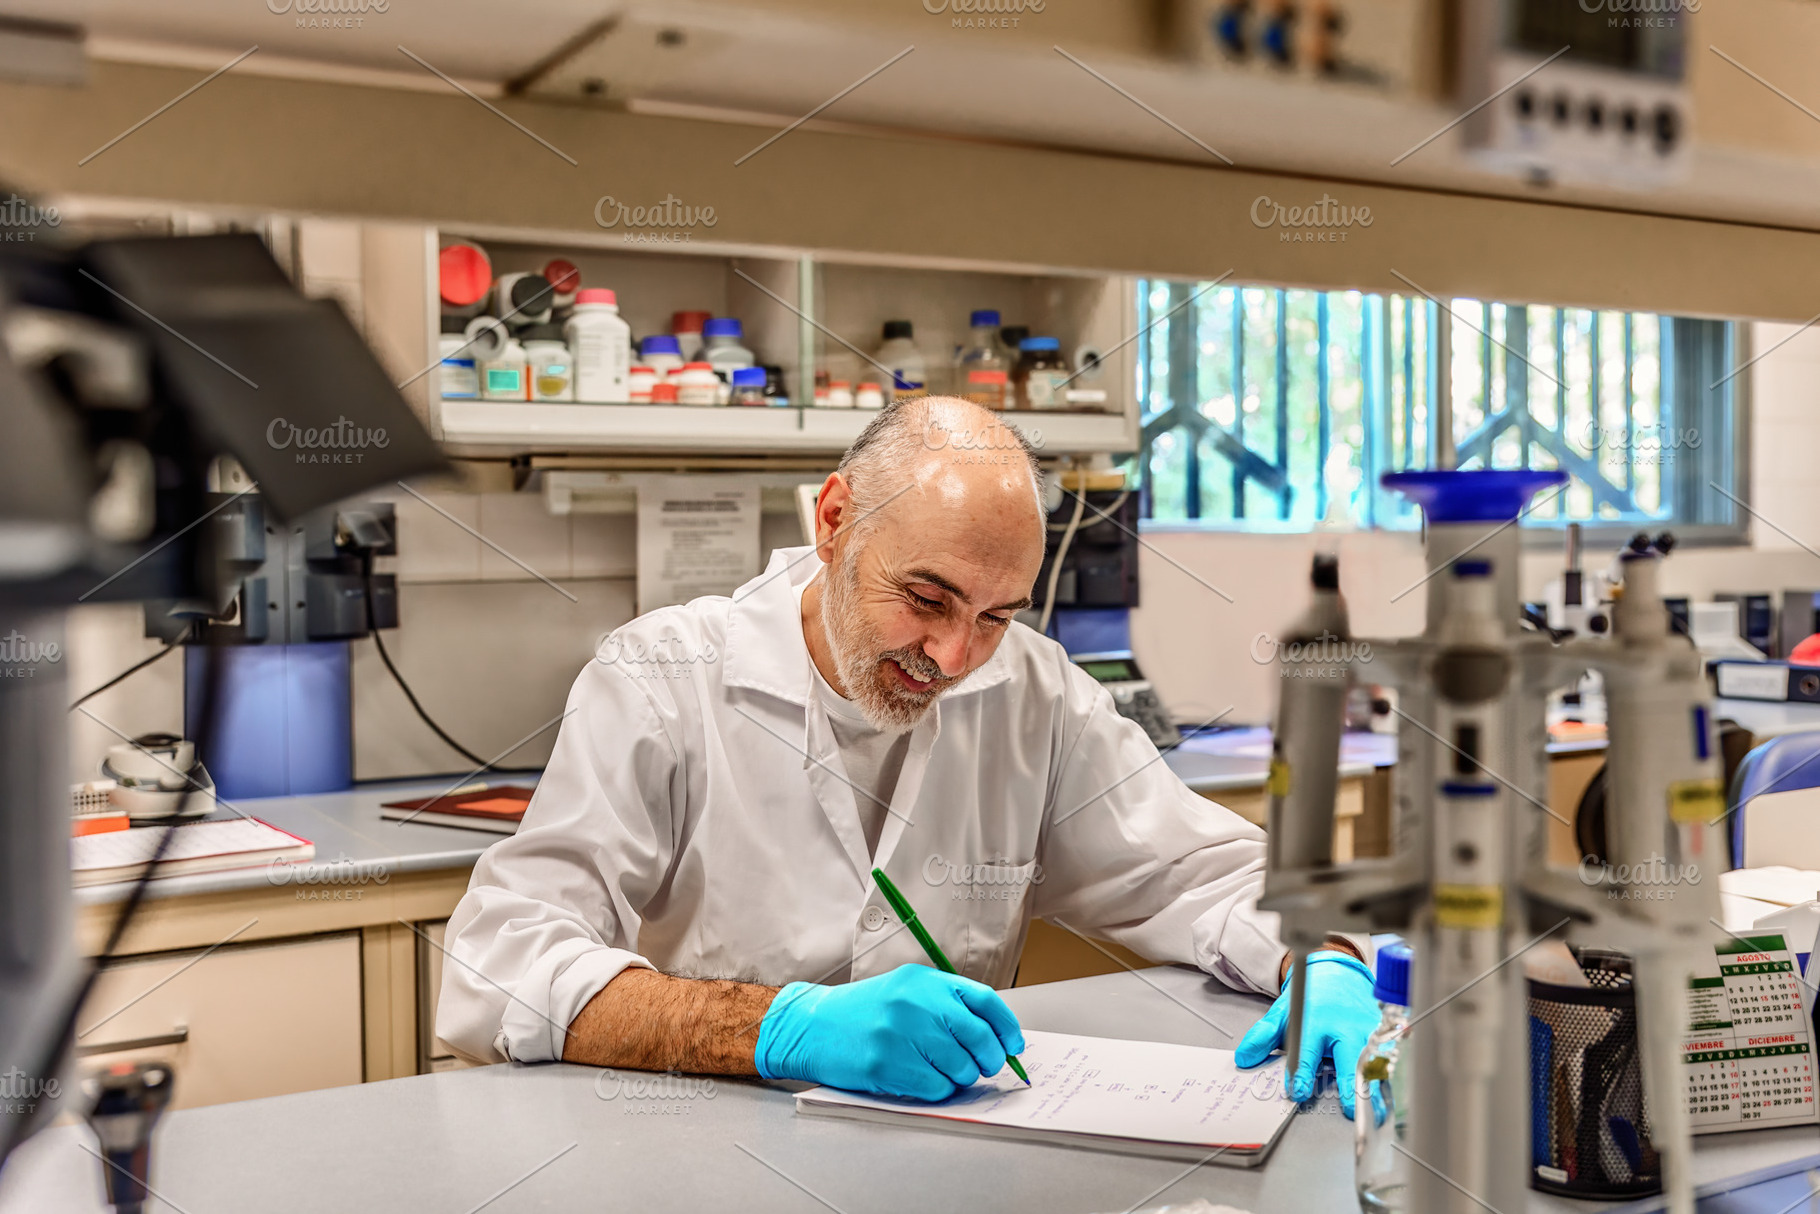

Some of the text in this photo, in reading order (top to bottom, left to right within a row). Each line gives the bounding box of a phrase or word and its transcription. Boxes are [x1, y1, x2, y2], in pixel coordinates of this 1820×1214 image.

[1736, 953, 1771, 963] AGOSTO
[1748, 1034, 1795, 1046] DICIEMBRE
[1680, 1041, 1724, 1051] VIEMBRE
